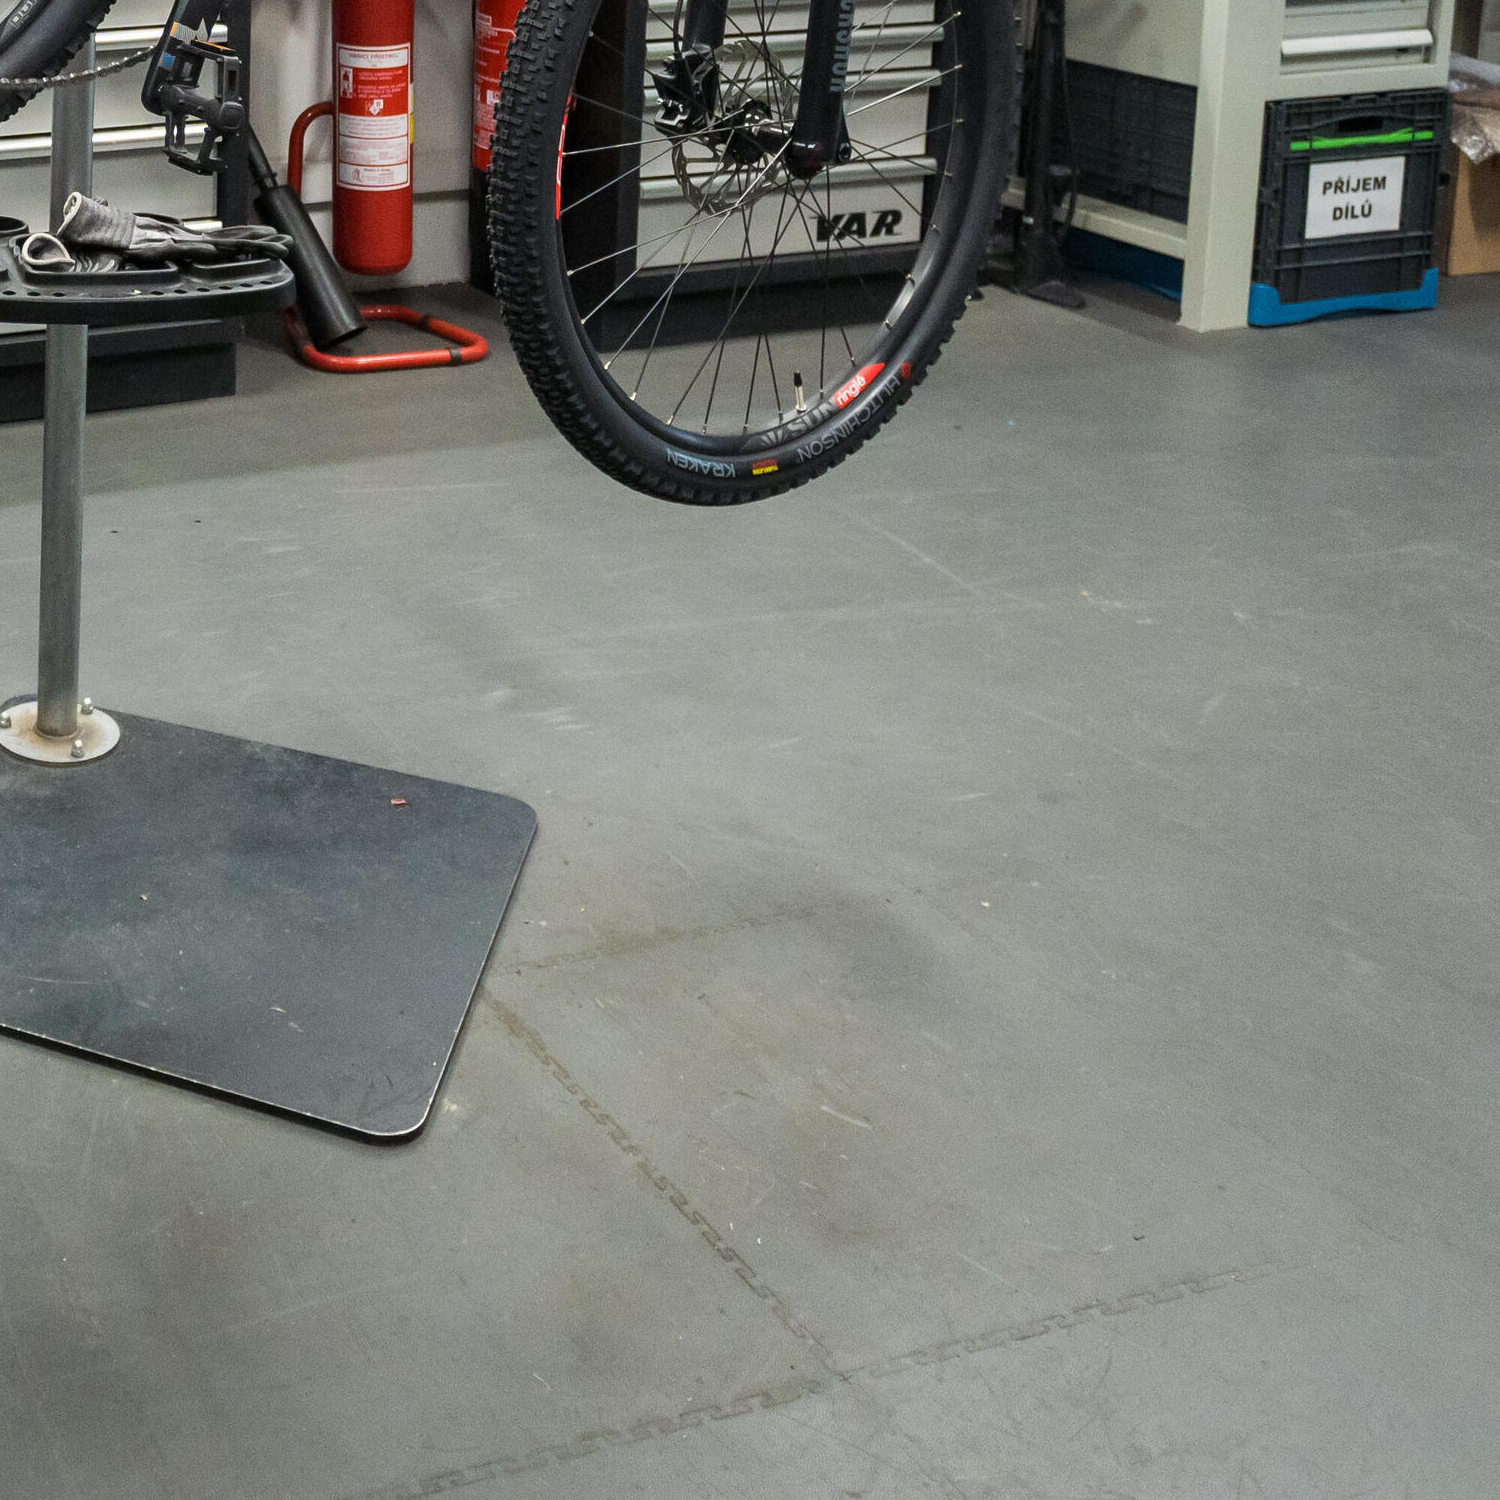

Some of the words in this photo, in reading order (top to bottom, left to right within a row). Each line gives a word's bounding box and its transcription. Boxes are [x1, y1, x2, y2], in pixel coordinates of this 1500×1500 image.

[1323, 175, 1387, 196] PŘÍJEM
[1332, 198, 1372, 221] DÍLŮ
[810, 209, 904, 242] VAR
[836, 375, 867, 406] ringlé
[797, 373, 900, 463] HUTCHINSON
[666, 448, 736, 478] KRAKEN
